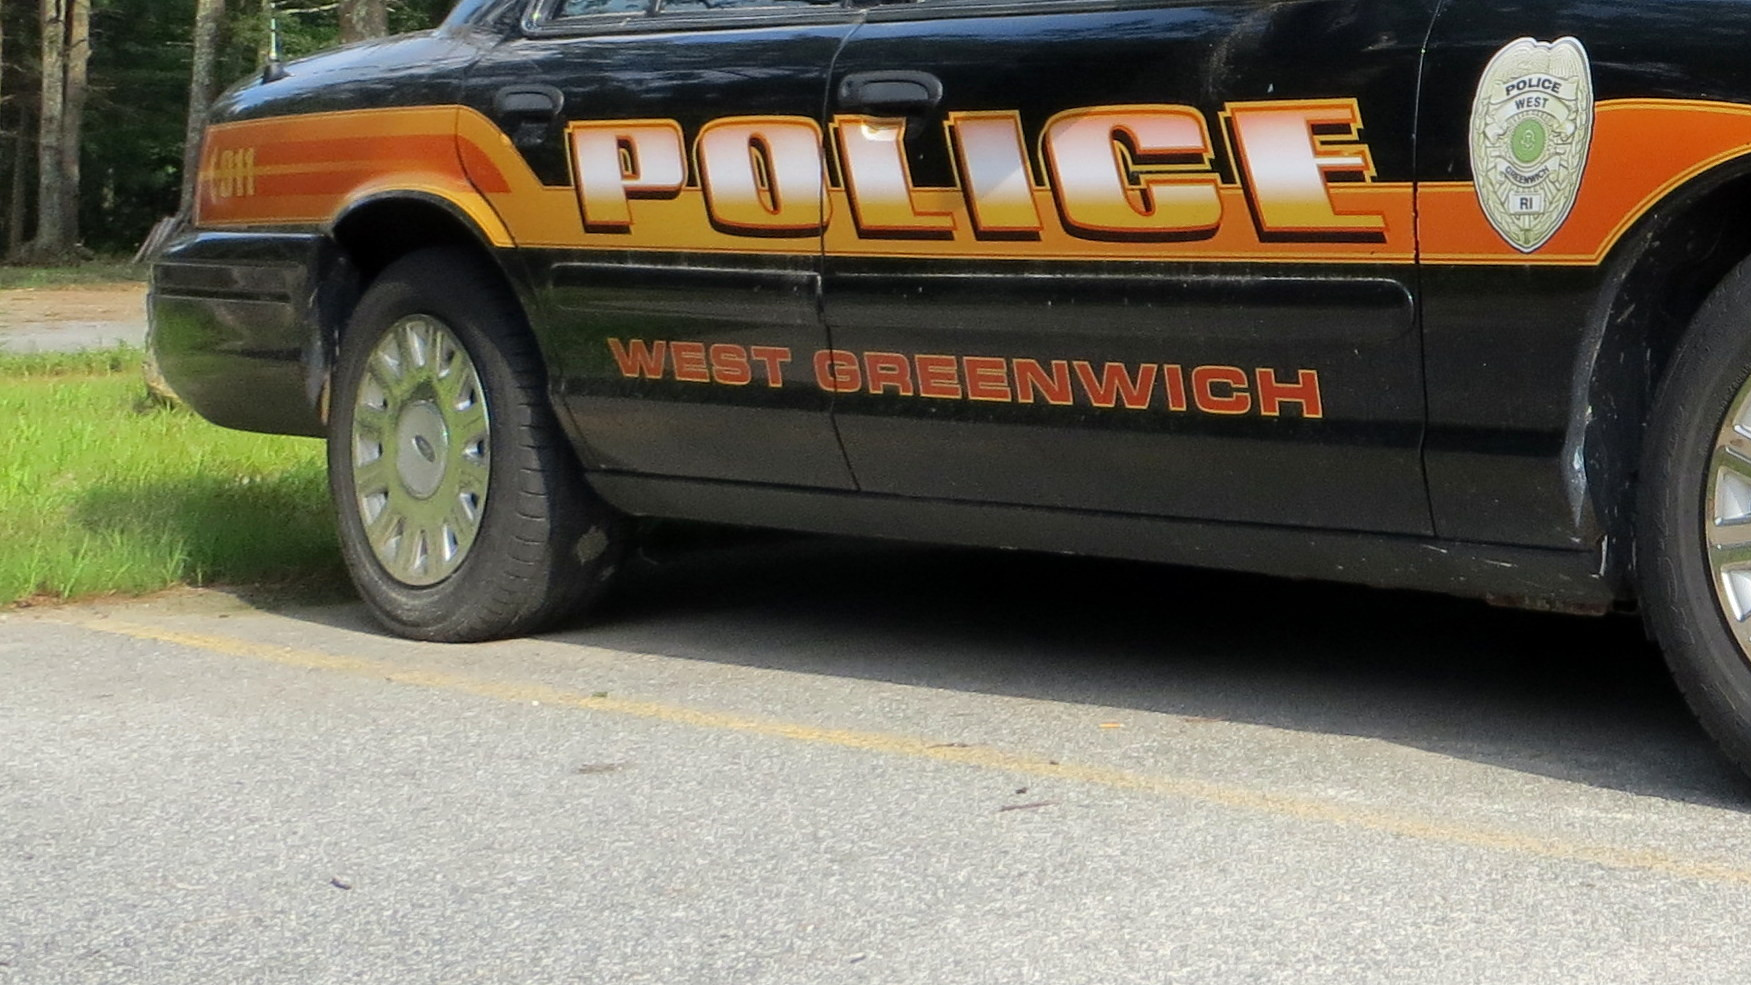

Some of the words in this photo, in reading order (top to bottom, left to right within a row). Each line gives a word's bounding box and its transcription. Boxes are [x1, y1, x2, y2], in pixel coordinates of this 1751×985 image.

[1505, 77, 1562, 96] POLICE
[1515, 96, 1549, 110] WEST
[566, 97, 1390, 244] POLICE
[1505, 165, 1549, 184] GREENWICH
[1520, 197, 1533, 210] RI
[607, 338, 791, 388] WEST
[812, 349, 1323, 418] GREENWICH
